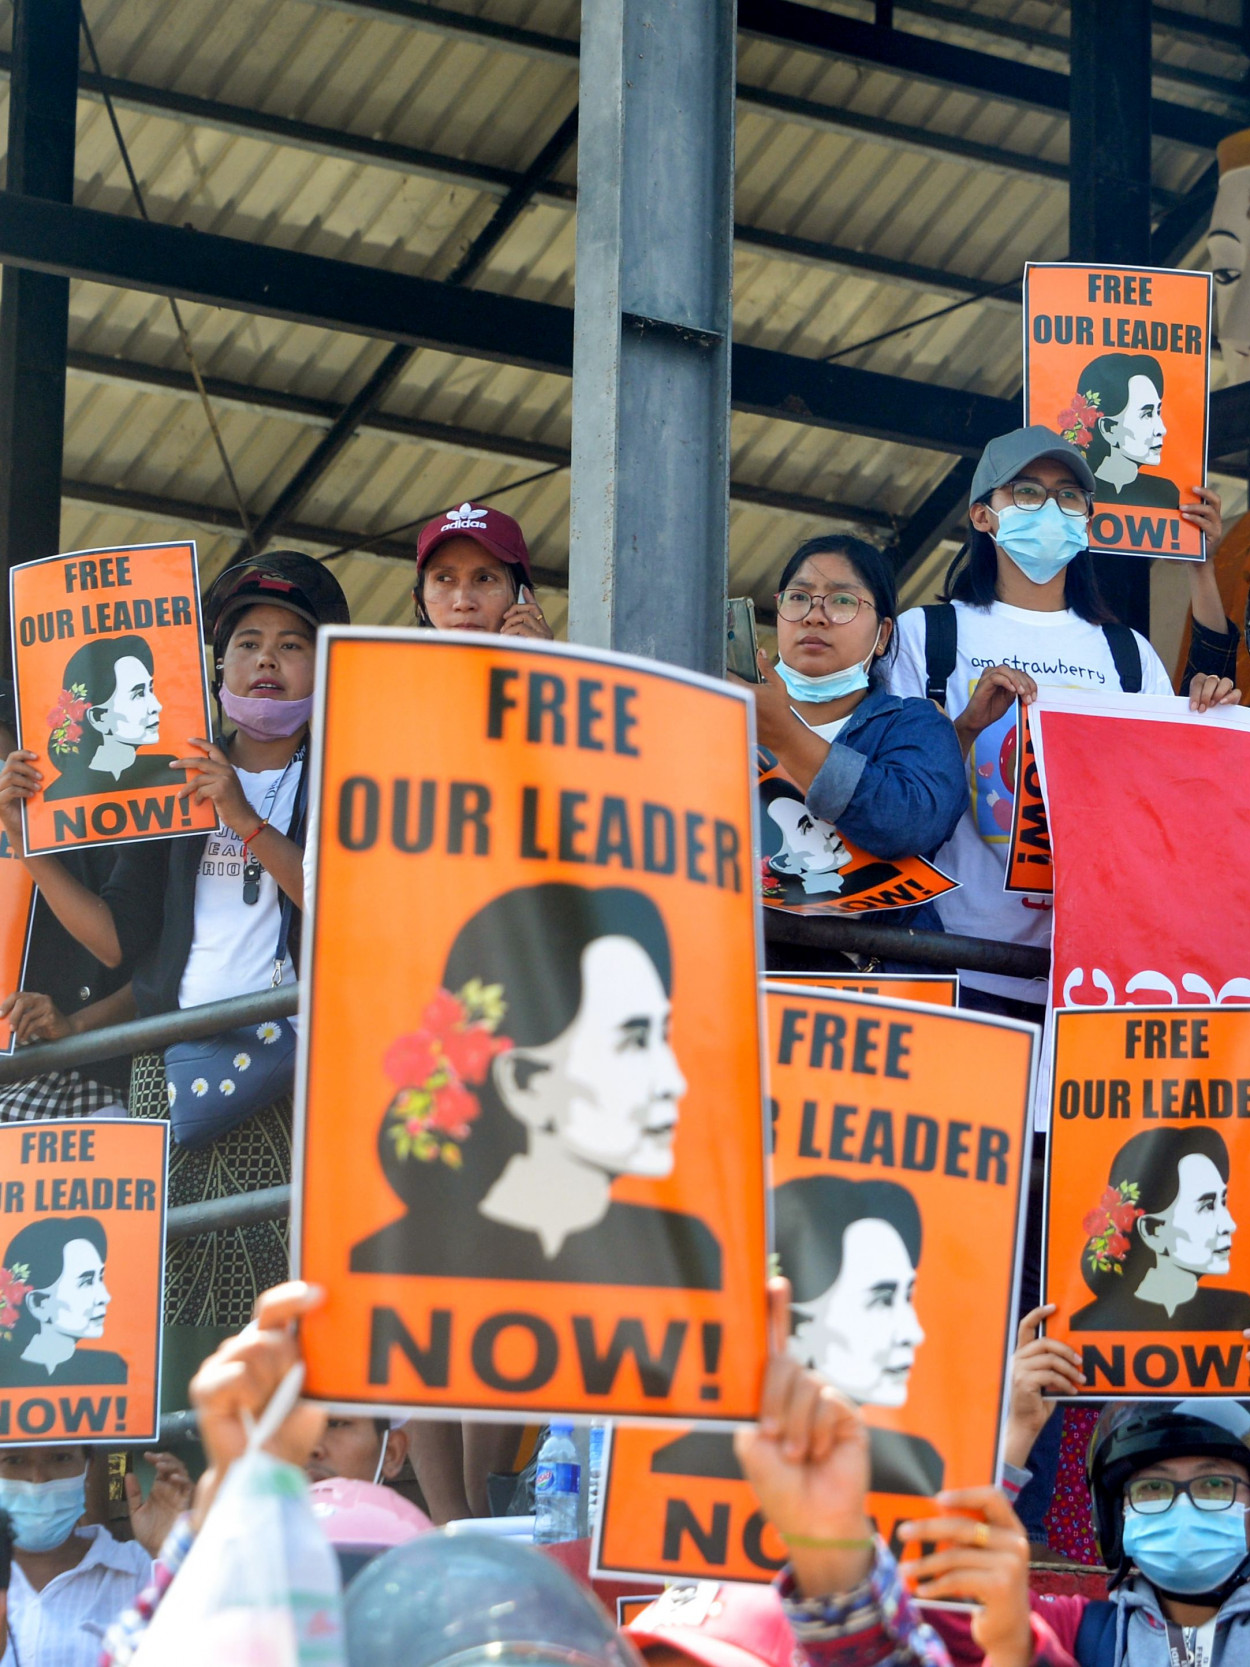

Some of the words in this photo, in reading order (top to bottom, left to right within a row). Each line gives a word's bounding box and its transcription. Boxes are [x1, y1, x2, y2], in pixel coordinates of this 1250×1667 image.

[1087, 272, 1154, 307] FREE
[1031, 313, 1095, 347] OUR
[1102, 317, 1203, 355] LEADER
[440, 519, 488, 532] adidas
[1091, 512, 1181, 550] OW!
[64, 555, 133, 595] FREE
[19, 607, 75, 647] OUR
[81, 595, 193, 637] LEADER
[487, 667, 642, 759] FREE
[53, 796, 193, 844] NOW!
[338, 777, 491, 856] OUR
[520, 787, 741, 893] LEADER
[778, 1008, 913, 1080] FREE
[1125, 1020, 1209, 1059] FREE
[1059, 1079, 1131, 1119] OUR
[21, 1129, 96, 1164] FREE
[799, 1100, 1011, 1186] LEADER
[34, 1178, 156, 1212] LEADER
[367, 1307, 724, 1401] NOW!
[0, 1396, 127, 1435] OW!
